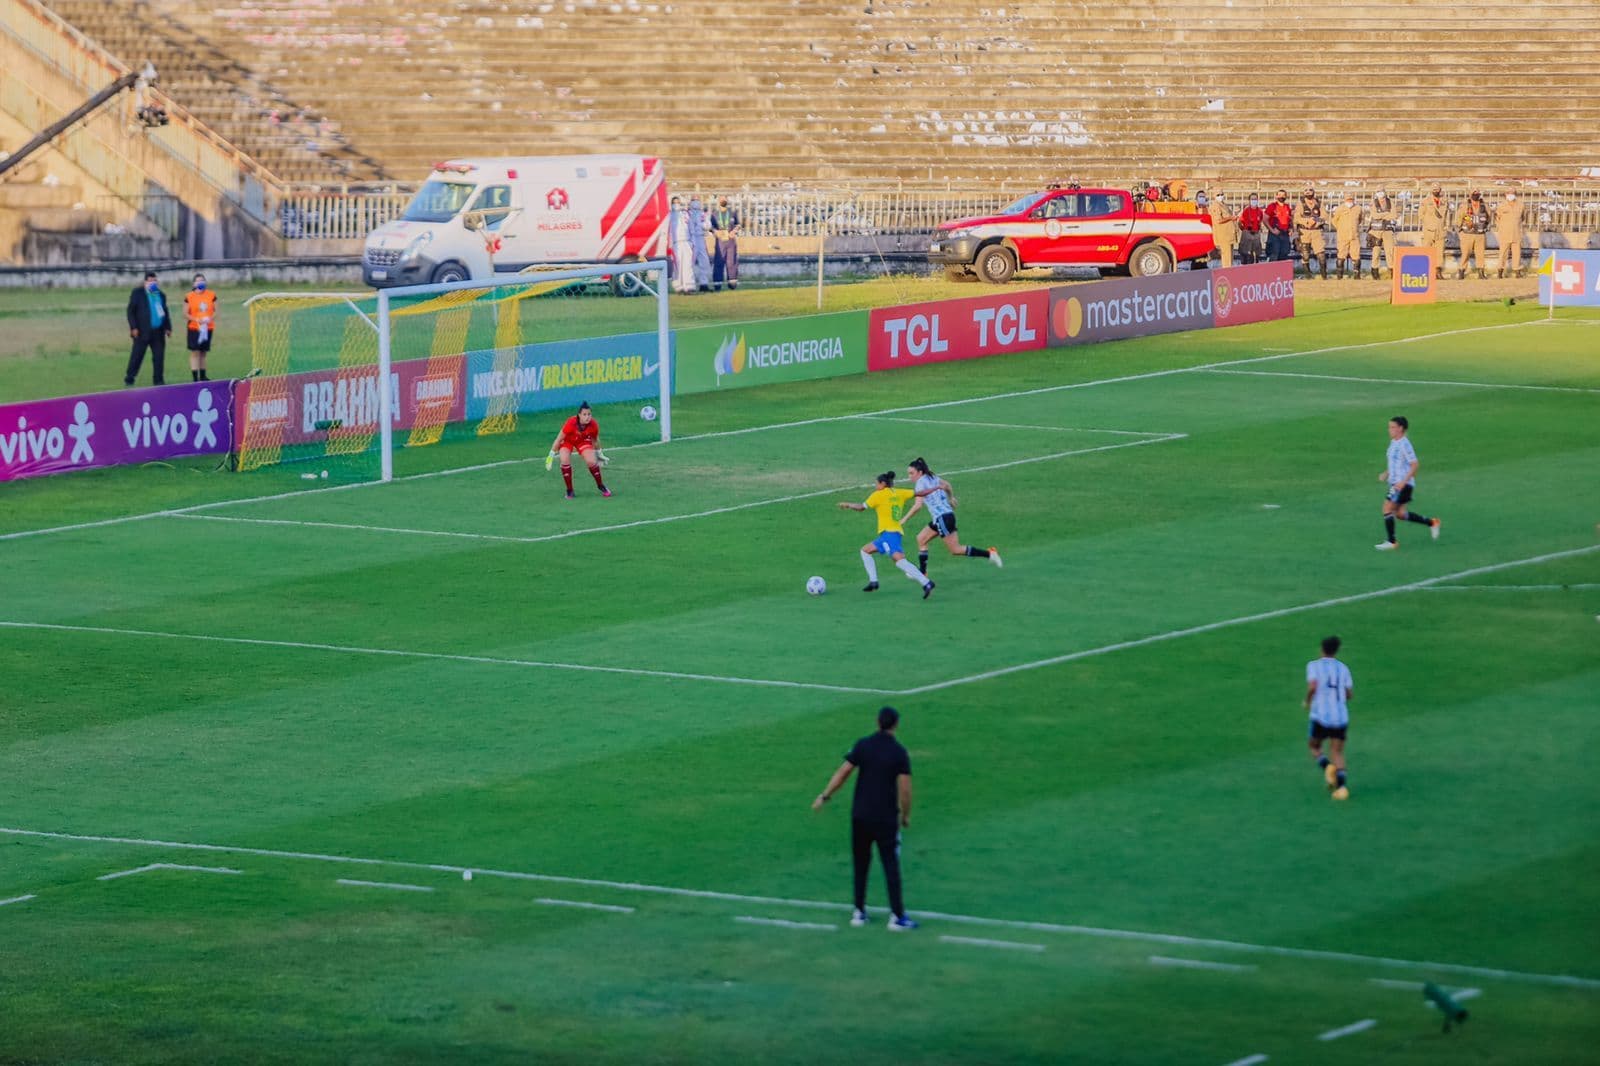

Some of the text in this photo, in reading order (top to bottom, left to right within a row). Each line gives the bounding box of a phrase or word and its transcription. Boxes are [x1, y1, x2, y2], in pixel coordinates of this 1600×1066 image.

[1233, 276, 1293, 305] 3 CORAÇÕES
[1402, 272, 1428, 288] Itaú
[973, 304, 1036, 347] TCL
[1087, 280, 1212, 329] mastercard
[748, 337, 844, 369] NEOENERGIA
[884, 314, 948, 358] TCL
[0, 416, 64, 464] vivo
[123, 402, 188, 448] vivo
[1327, 675, 1340, 702] 4
